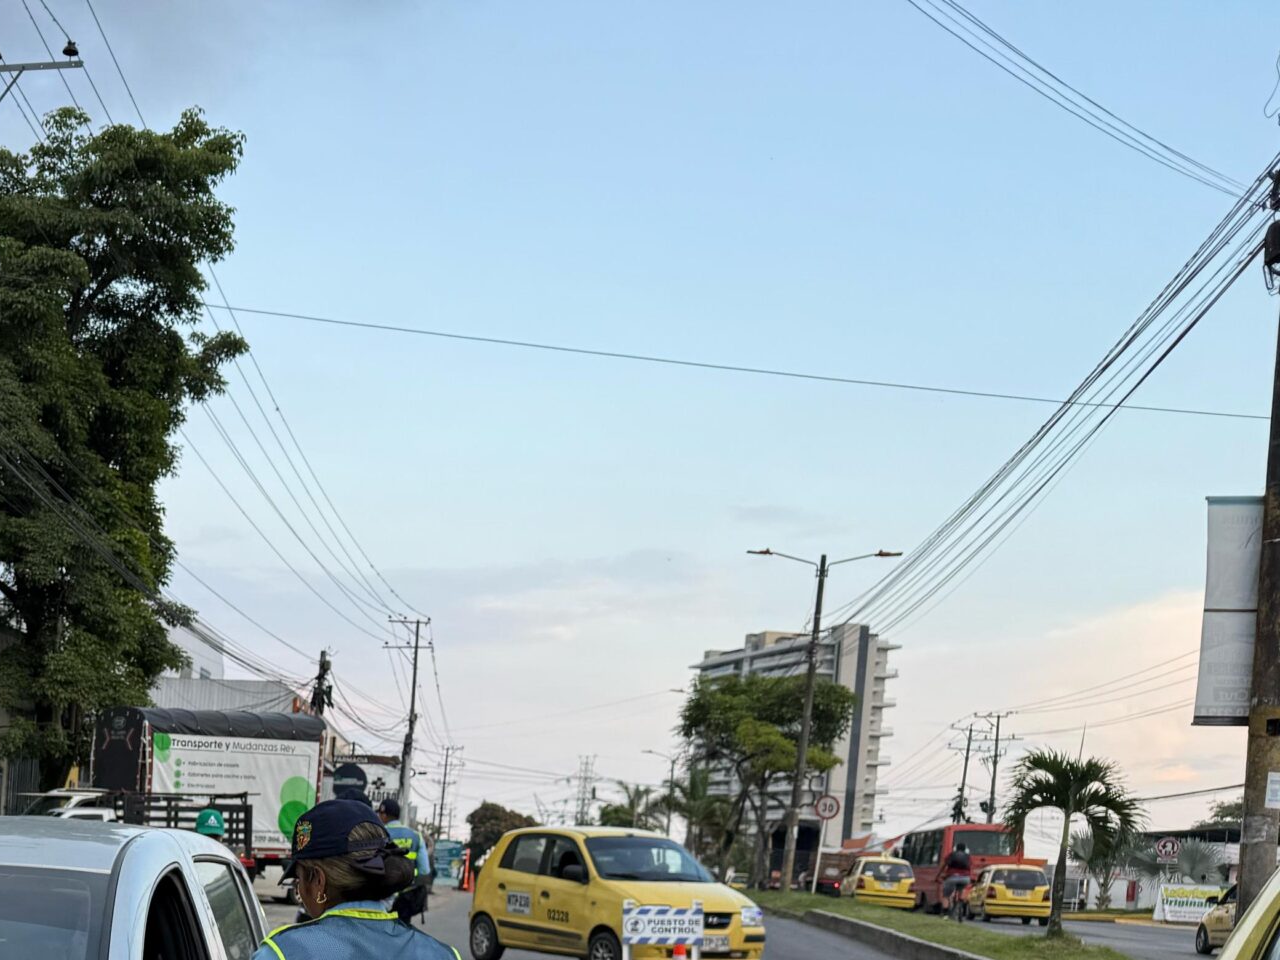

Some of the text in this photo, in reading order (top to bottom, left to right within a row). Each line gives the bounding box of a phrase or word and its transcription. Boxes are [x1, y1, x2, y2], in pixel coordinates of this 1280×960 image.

[172, 738, 296, 753] Transporte y Mudanzas Rey
[822, 802, 834, 813] 30
[647, 918, 685, 926] PUESTO
[651, 926, 697, 934] CONTROL
